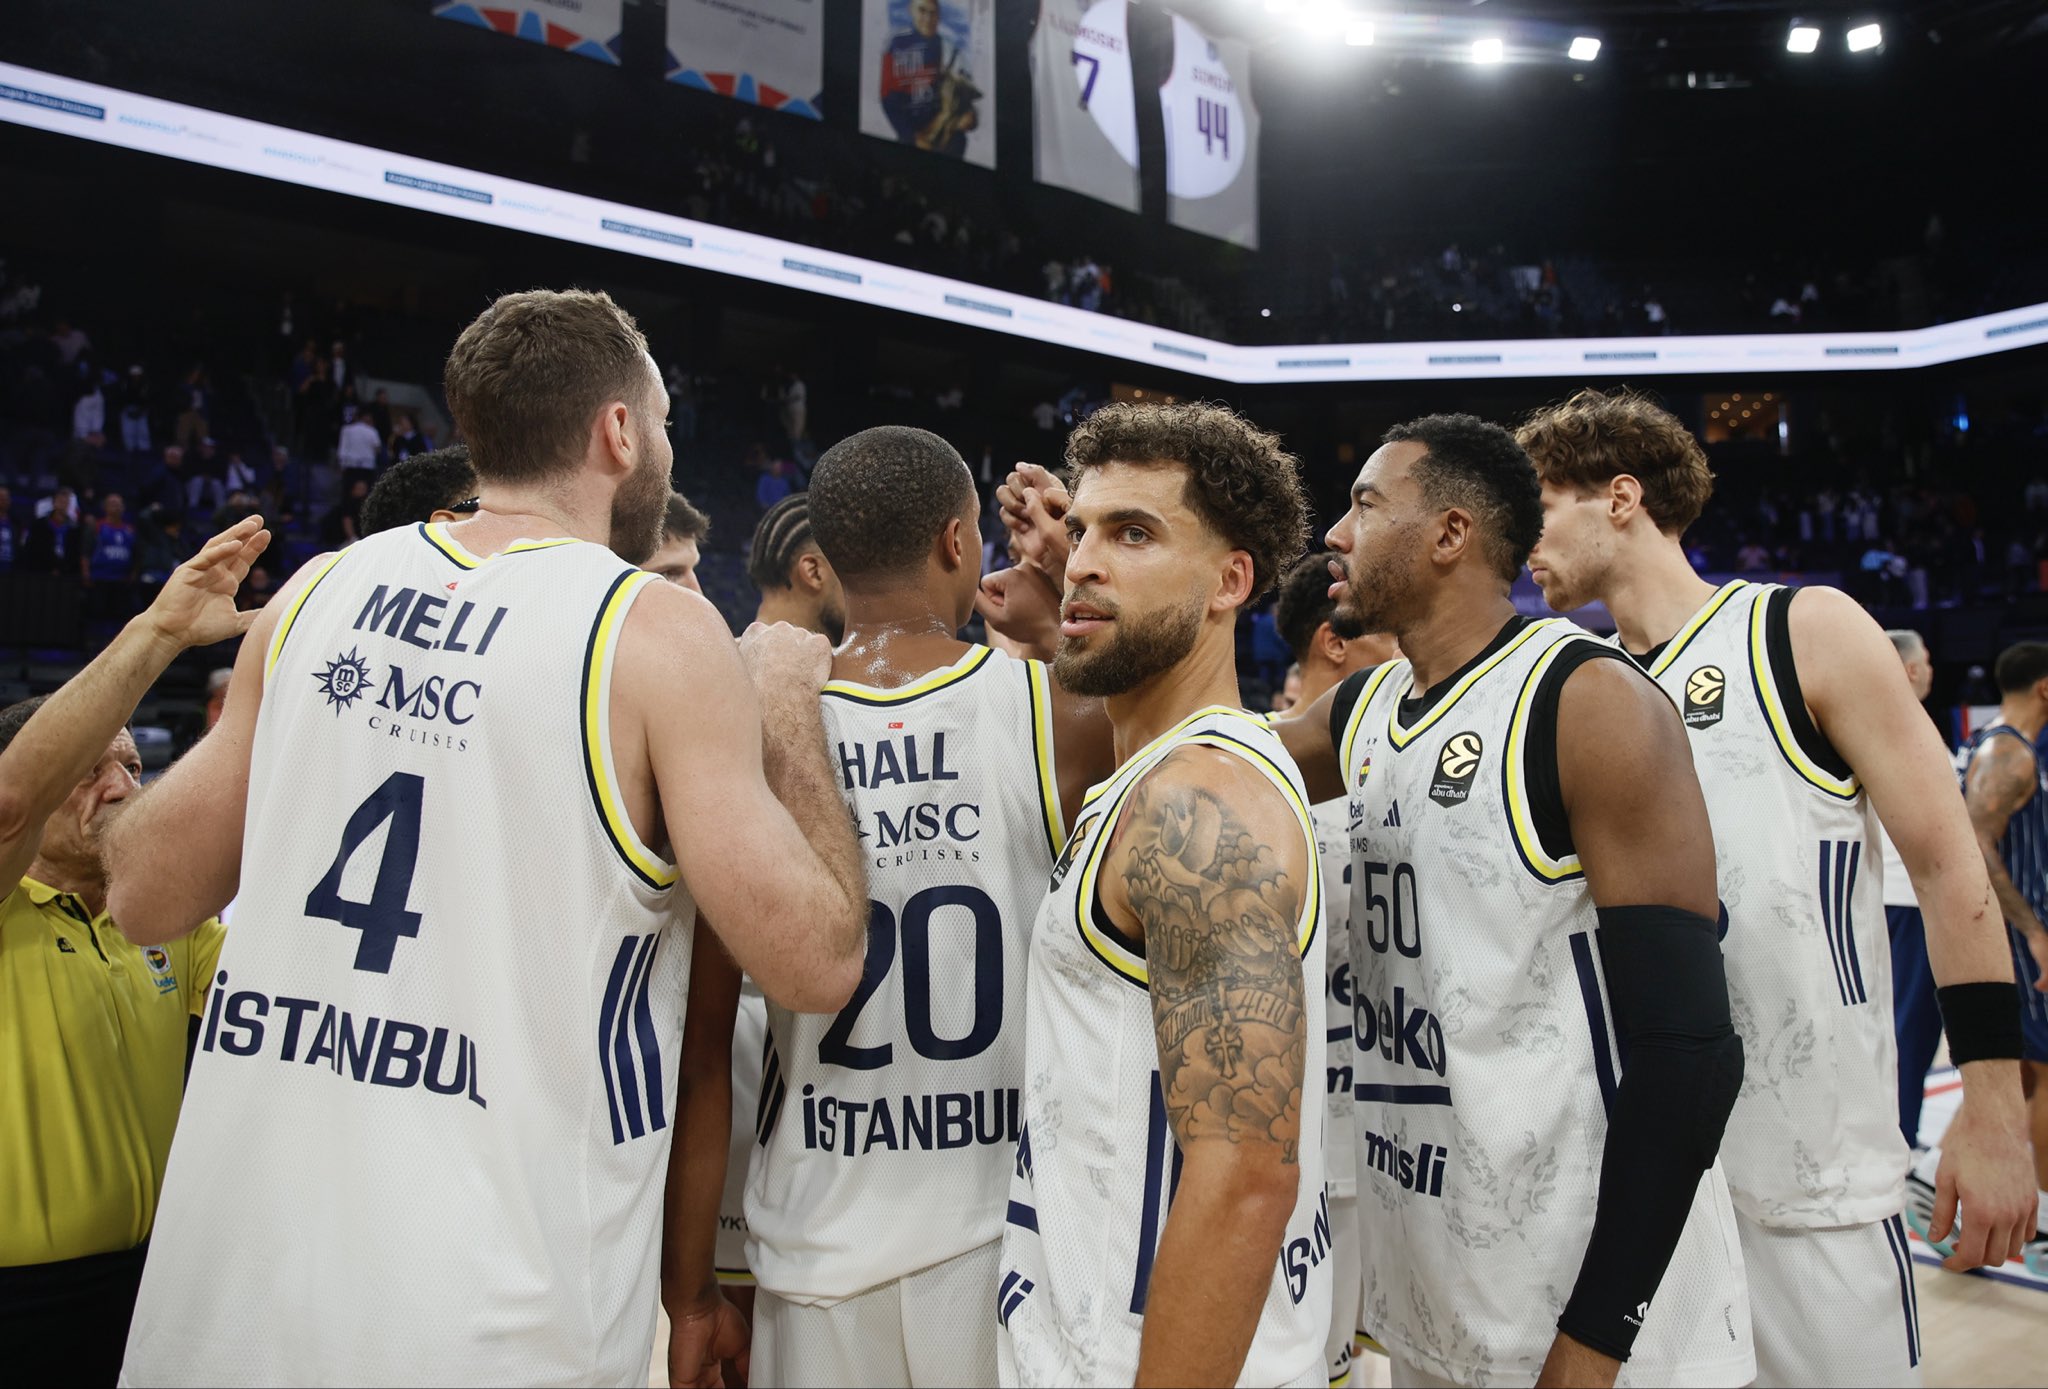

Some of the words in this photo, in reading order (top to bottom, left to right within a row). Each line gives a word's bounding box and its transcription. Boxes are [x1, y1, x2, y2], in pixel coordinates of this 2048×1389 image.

[1071, 48, 1099, 111] 7
[1196, 96, 1229, 160] 44
[375, 664, 482, 726] MSC
[368, 716, 468, 752] CRUISES
[838, 732, 959, 790] HALL
[873, 802, 980, 849] MSC
[304, 771, 425, 975] 4
[876, 849, 980, 869] CRUISES
[1363, 861, 1422, 959] 50
[818, 885, 1003, 1070] 20
[202, 969, 488, 1110] İSTANBUL
[1351, 975, 1447, 1078] beko
[802, 1083, 1022, 1158] İSTANBUL
[1365, 1130, 1448, 1198] misli
